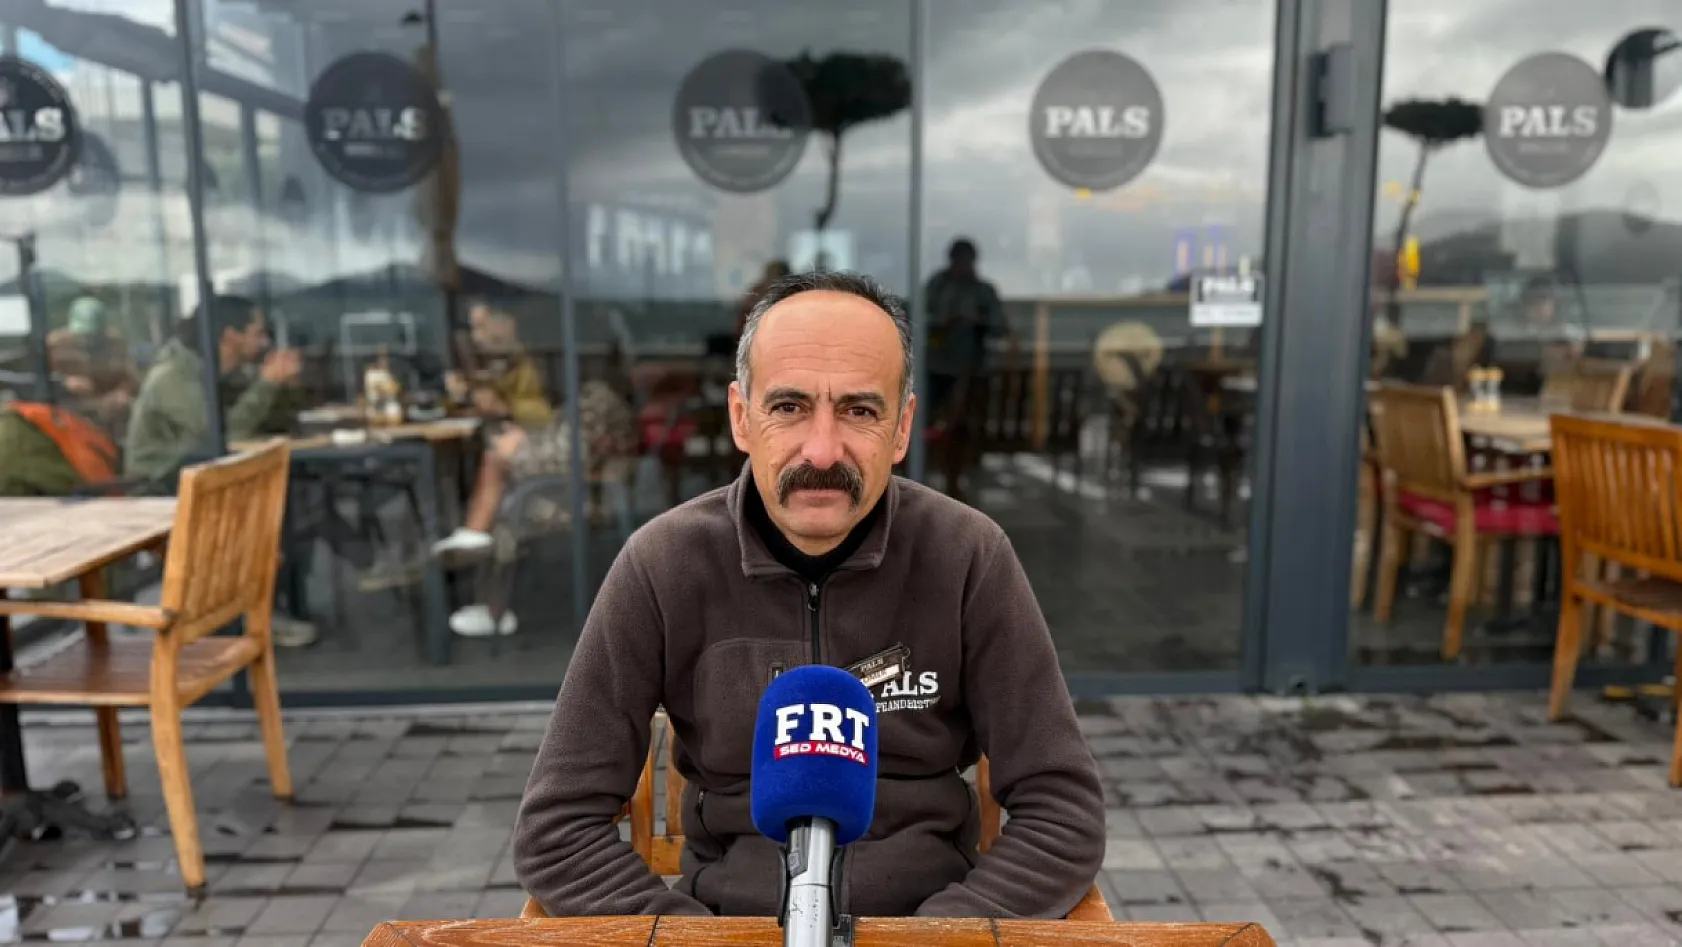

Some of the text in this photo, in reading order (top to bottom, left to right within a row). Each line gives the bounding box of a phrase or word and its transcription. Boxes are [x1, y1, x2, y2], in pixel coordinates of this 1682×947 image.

[323, 106, 428, 140] PALS
[1045, 105, 1149, 138] PALS
[1499, 105, 1599, 137] PALS
[870, 671, 939, 698] ALS
[775, 704, 869, 750] FRT
[779, 743, 866, 764] SED MEDYA
